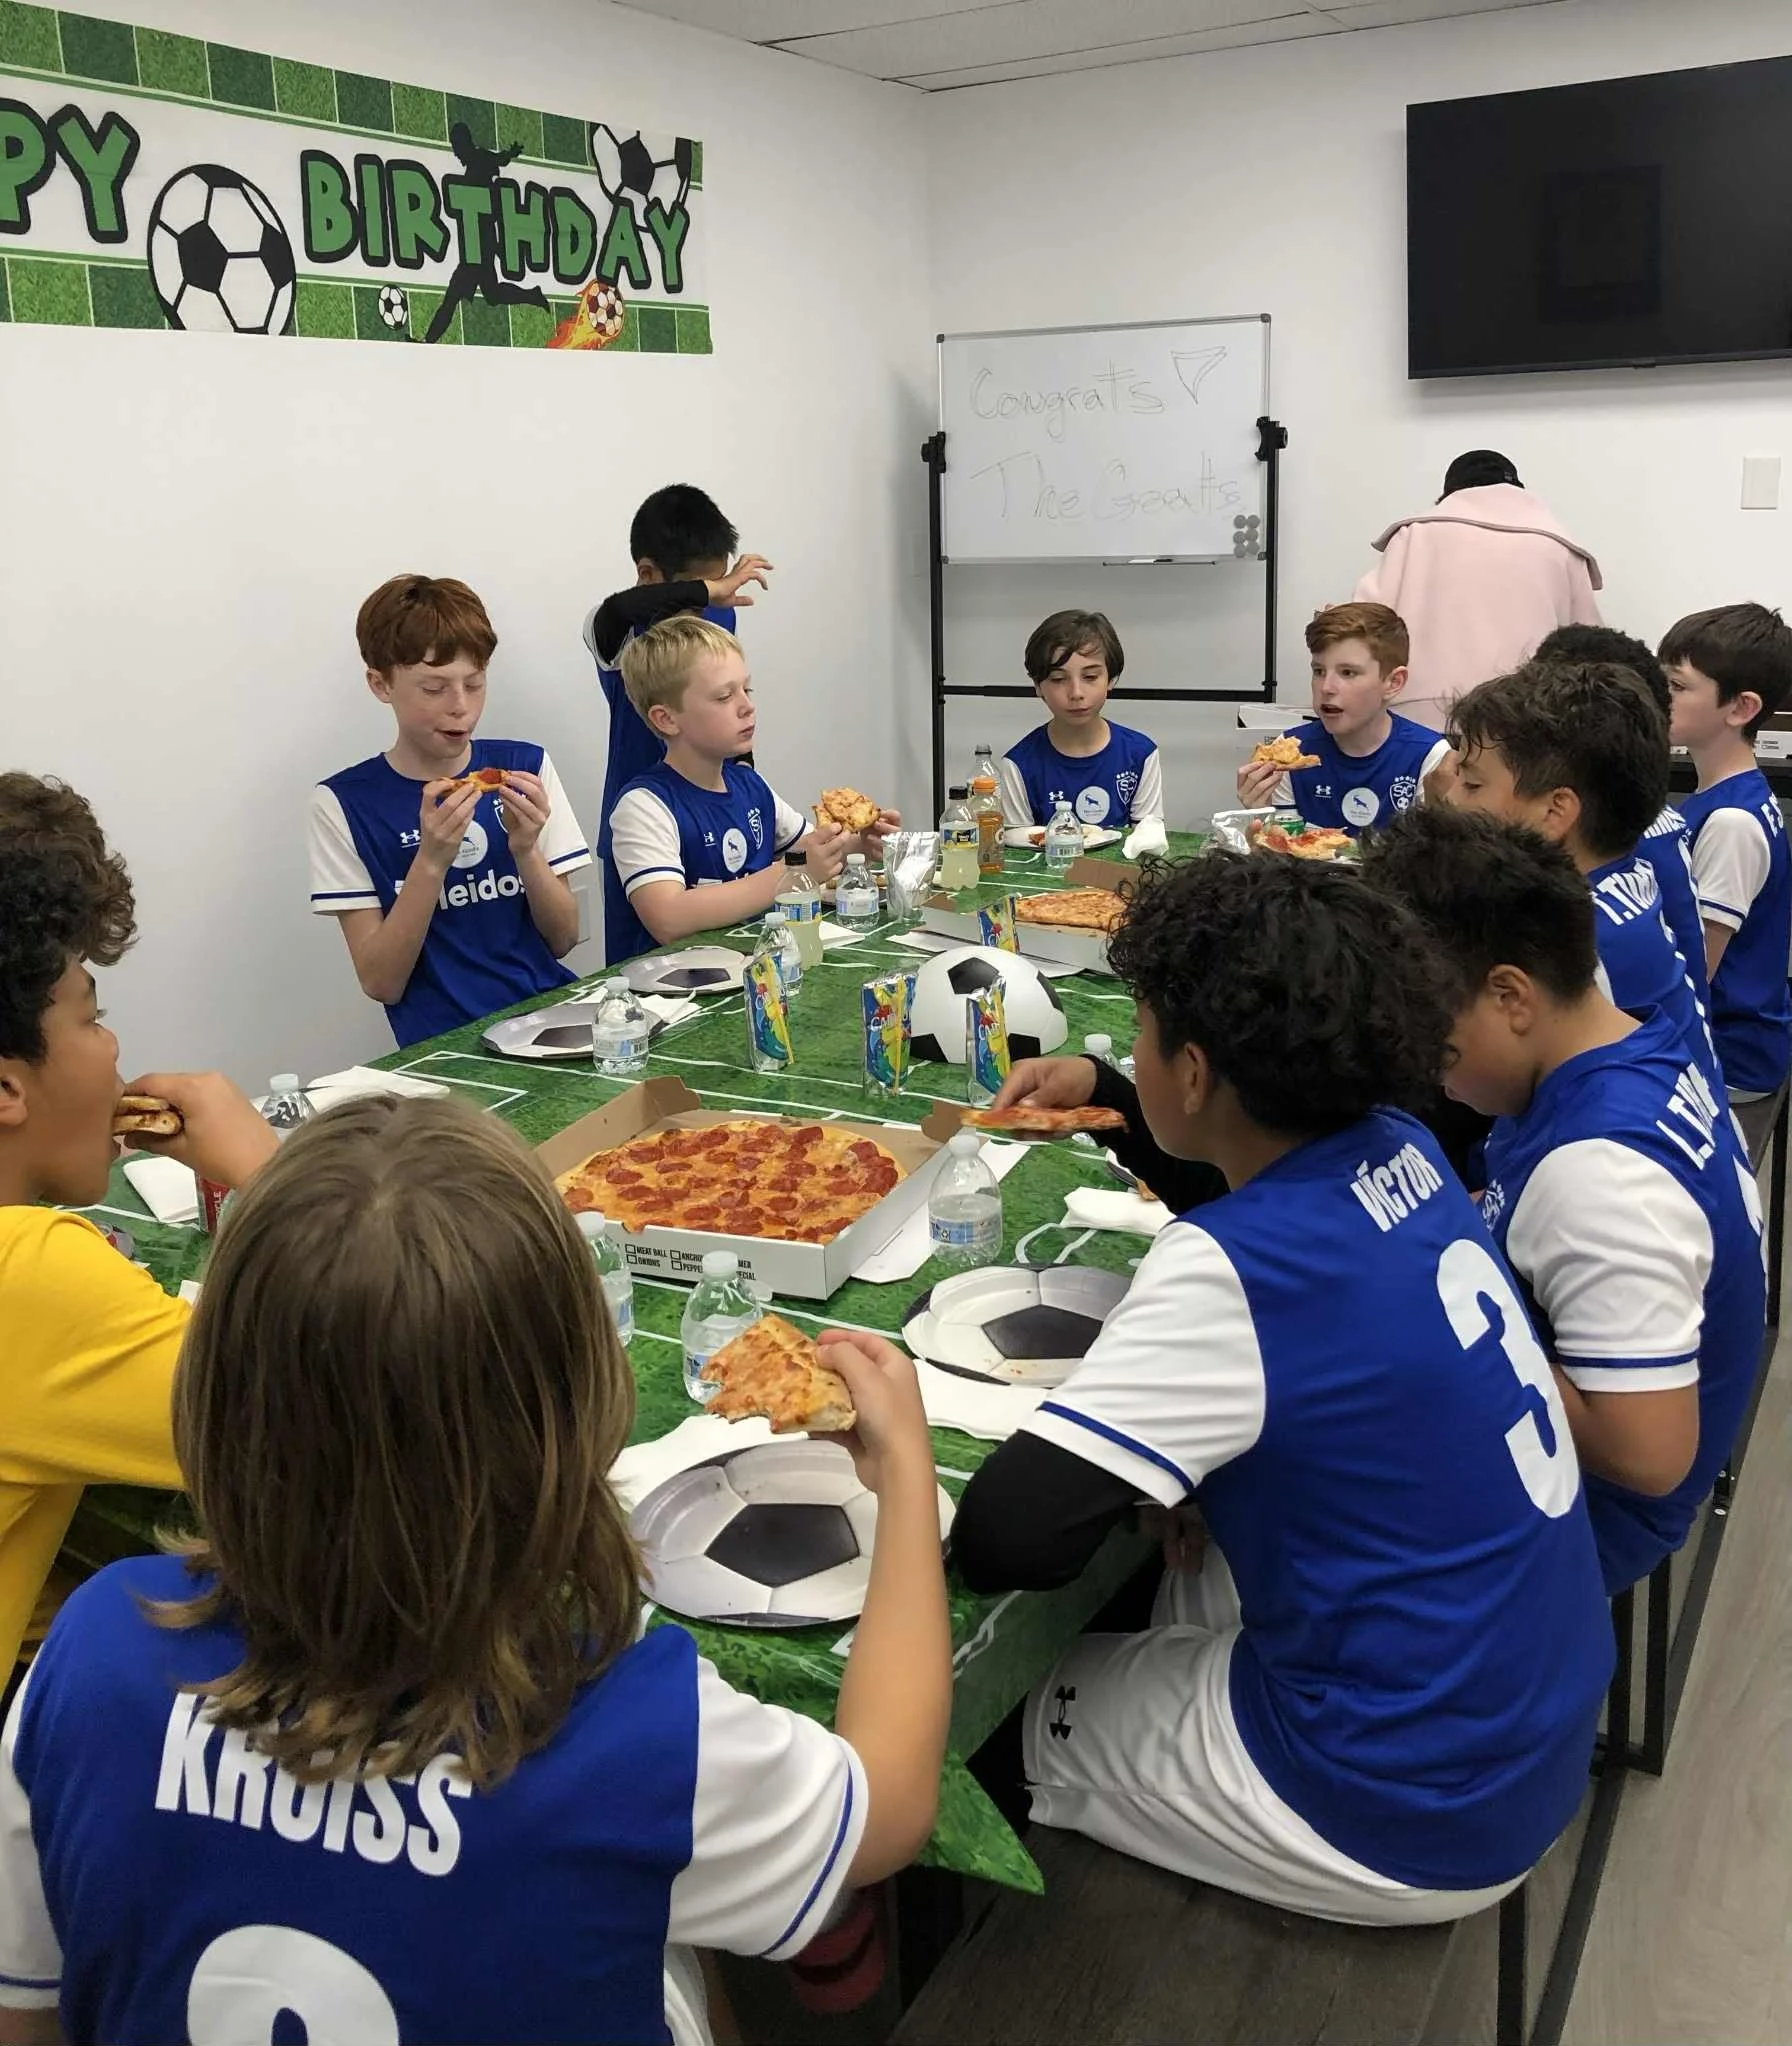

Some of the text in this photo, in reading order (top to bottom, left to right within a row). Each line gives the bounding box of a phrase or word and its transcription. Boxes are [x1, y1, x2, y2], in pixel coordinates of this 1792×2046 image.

[300, 149, 690, 294] BIRTHDAY
[969, 359, 1166, 441] Congrats
[970, 451, 1082, 519] The
[1350, 1142, 1444, 1233] VÍCTOR
[637, 1246, 667, 1257] MEAT BALL
[638, 1257, 660, 1267] ONIONS
[681, 1253, 703, 1262] ANCHO
[682, 1263, 703, 1273] PEPPE
[1436, 1239, 1581, 1519] 3
